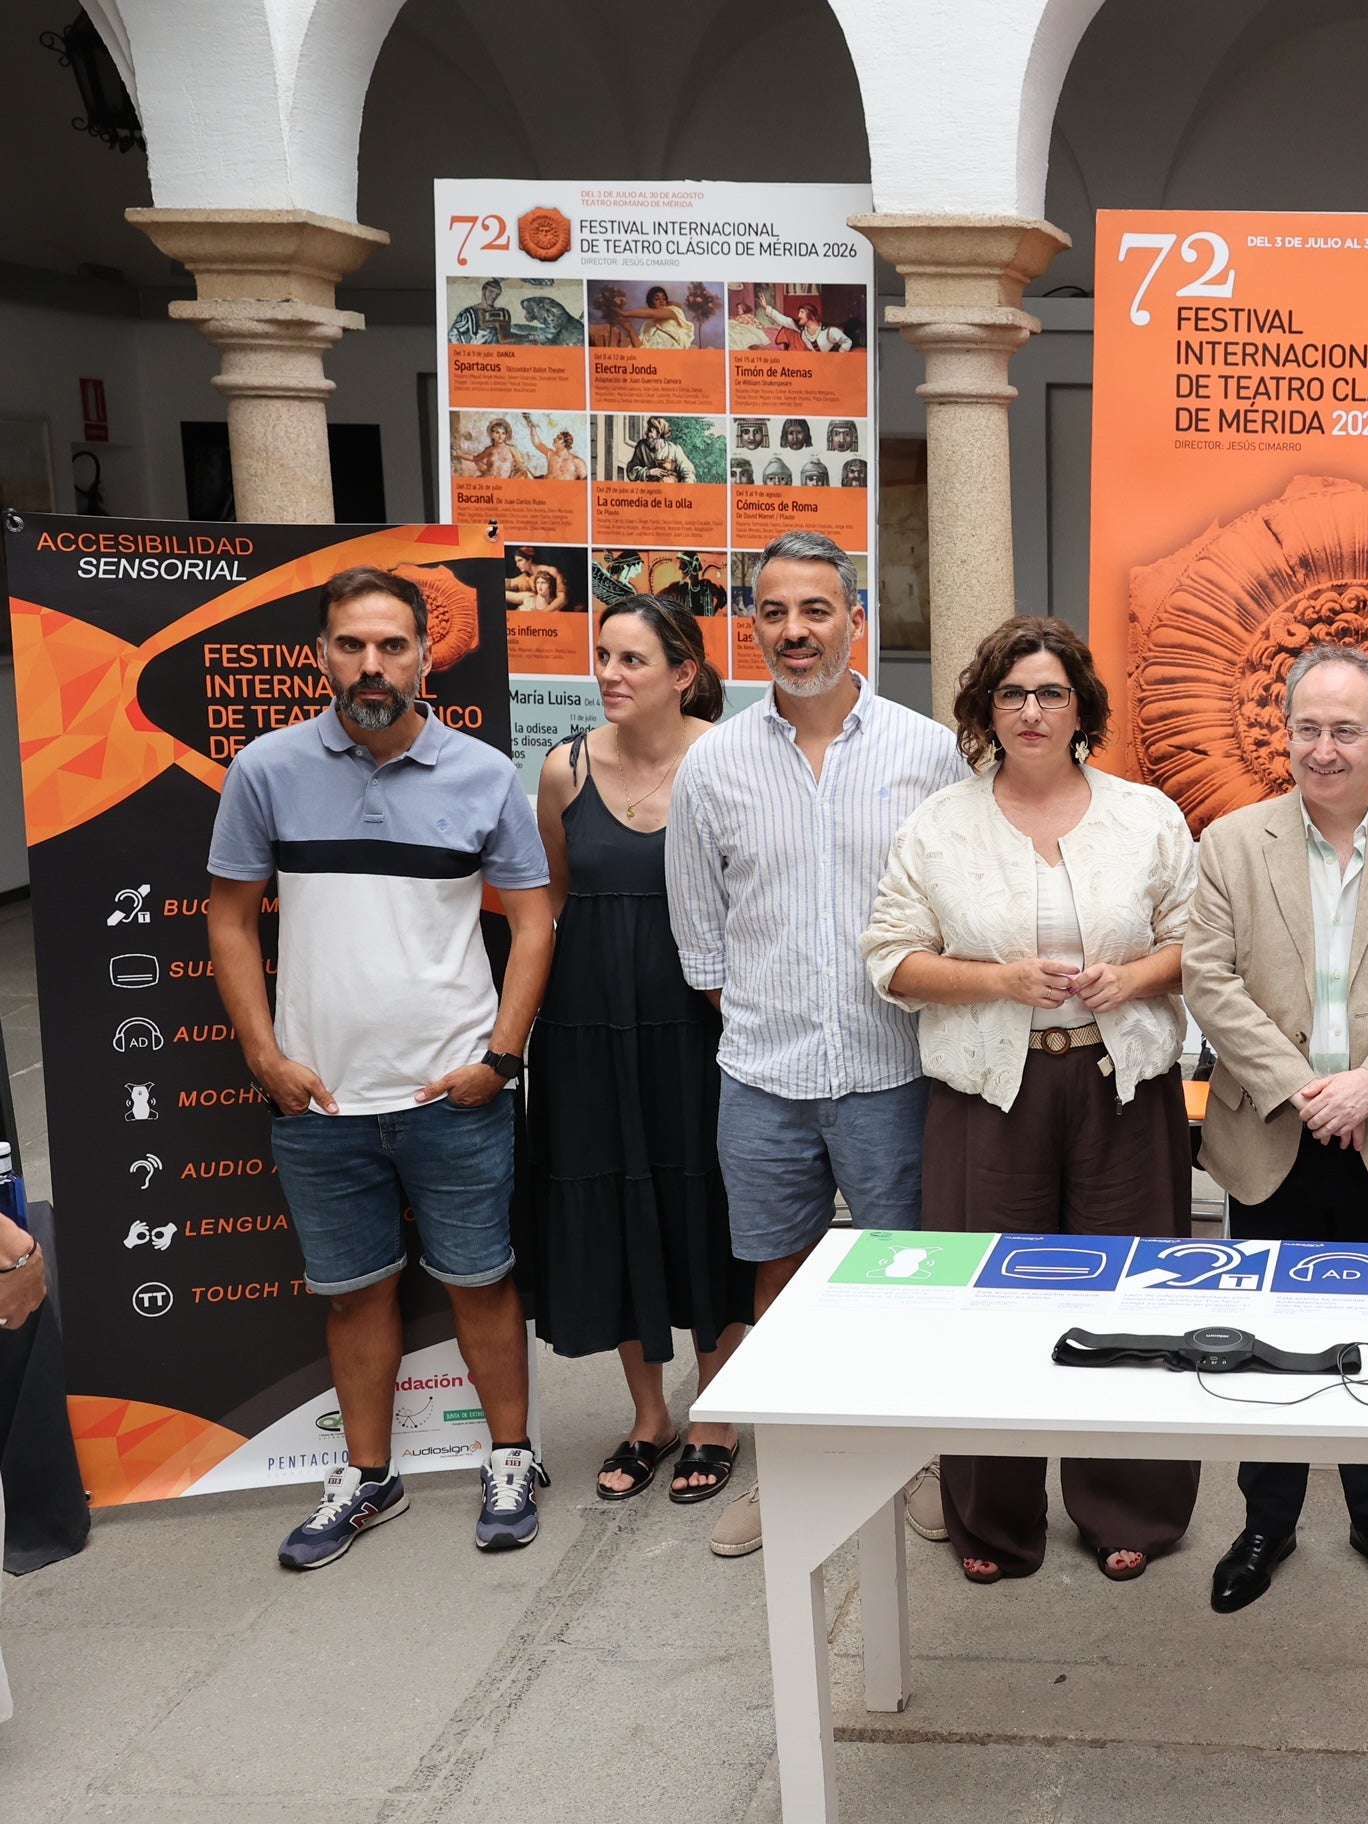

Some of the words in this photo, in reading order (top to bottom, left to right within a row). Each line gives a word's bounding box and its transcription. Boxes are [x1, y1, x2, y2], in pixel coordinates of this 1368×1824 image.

[581, 190, 594, 198] DEL
[615, 191, 637, 199] JULIO
[638, 191, 648, 199] AL
[671, 192, 704, 200] AGOSTO
[581, 199, 611, 207] TEATRO
[612, 199, 649, 207] ROMANO
[663, 199, 693, 208] MÉRIDA
[580, 220, 649, 235] FESTIVAL
[653, 221, 780, 237] INTERNACIONAL
[449, 214, 510, 266] 72
[580, 239, 600, 253] DE
[603, 239, 662, 255] TEATRO
[666, 236, 731, 256] CLÁSICO
[735, 242, 755, 256] DE
[759, 238, 819, 257] MÉRIDA
[822, 242, 857, 258] 2026
[1247, 236, 1272, 247] DEL
[1274, 236, 1282, 247] 3
[1285, 237, 1302, 248] DE
[1304, 237, 1342, 248] JULIO
[1344, 238, 1361, 249] AL
[580, 258, 618, 266] DIRECTOR:
[621, 257, 644, 266] JESÚS
[646, 259, 680, 267] CIMARRO
[1118, 231, 1235, 326] 72
[1177, 306, 1303, 334] FESTIVAL
[454, 360, 502, 373] Spartacus
[595, 362, 628, 375] Electra
[629, 363, 657, 375] Jonda
[735, 365, 764, 377] Timón
[766, 367, 778, 377] de
[780, 367, 813, 378] Atenas
[1176, 374, 1211, 399] DE
[1218, 375, 1324, 401] TEATRO
[1175, 407, 1211, 432] DE
[1218, 401, 1325, 435] MÉRIDA
[1174, 440, 1224, 451] DIRECTOR:
[1226, 439, 1256, 452] JESÚS
[1258, 442, 1302, 452] CIMARRO
[457, 492, 494, 504] Bacanal
[597, 495, 608, 507] La
[610, 496, 649, 508] comedia
[650, 497, 662, 508] de
[664, 498, 673, 509] la
[675, 498, 693, 509] olla
[736, 499, 775, 511] Cómicos
[778, 501, 789, 511] de
[792, 501, 818, 512] Roma
[37, 532, 255, 556] ACCESIBILIDAD
[77, 557, 247, 581] SENSORIAL
[517, 625, 558, 637] infiernos
[737, 631, 753, 642] Las
[204, 644, 318, 668] FESTIVA
[509, 689, 544, 704] María
[548, 691, 581, 706] Luisa
[584, 698, 595, 706] Del
[208, 705, 245, 729] DE
[514, 722, 524, 733] la
[526, 723, 558, 734] odisea
[210, 736, 246, 758] DE
[521, 736, 553, 747] diosas
[129, 1037, 148, 1048] AD
[180, 1159, 263, 1179] AUDIO
[185, 1214, 288, 1236] LENGUA
[1322, 1269, 1361, 1280] AD
[139, 1291, 166, 1307] TT
[192, 1282, 279, 1303] TOUCH
[402, 1444, 469, 1457] Audiosign
